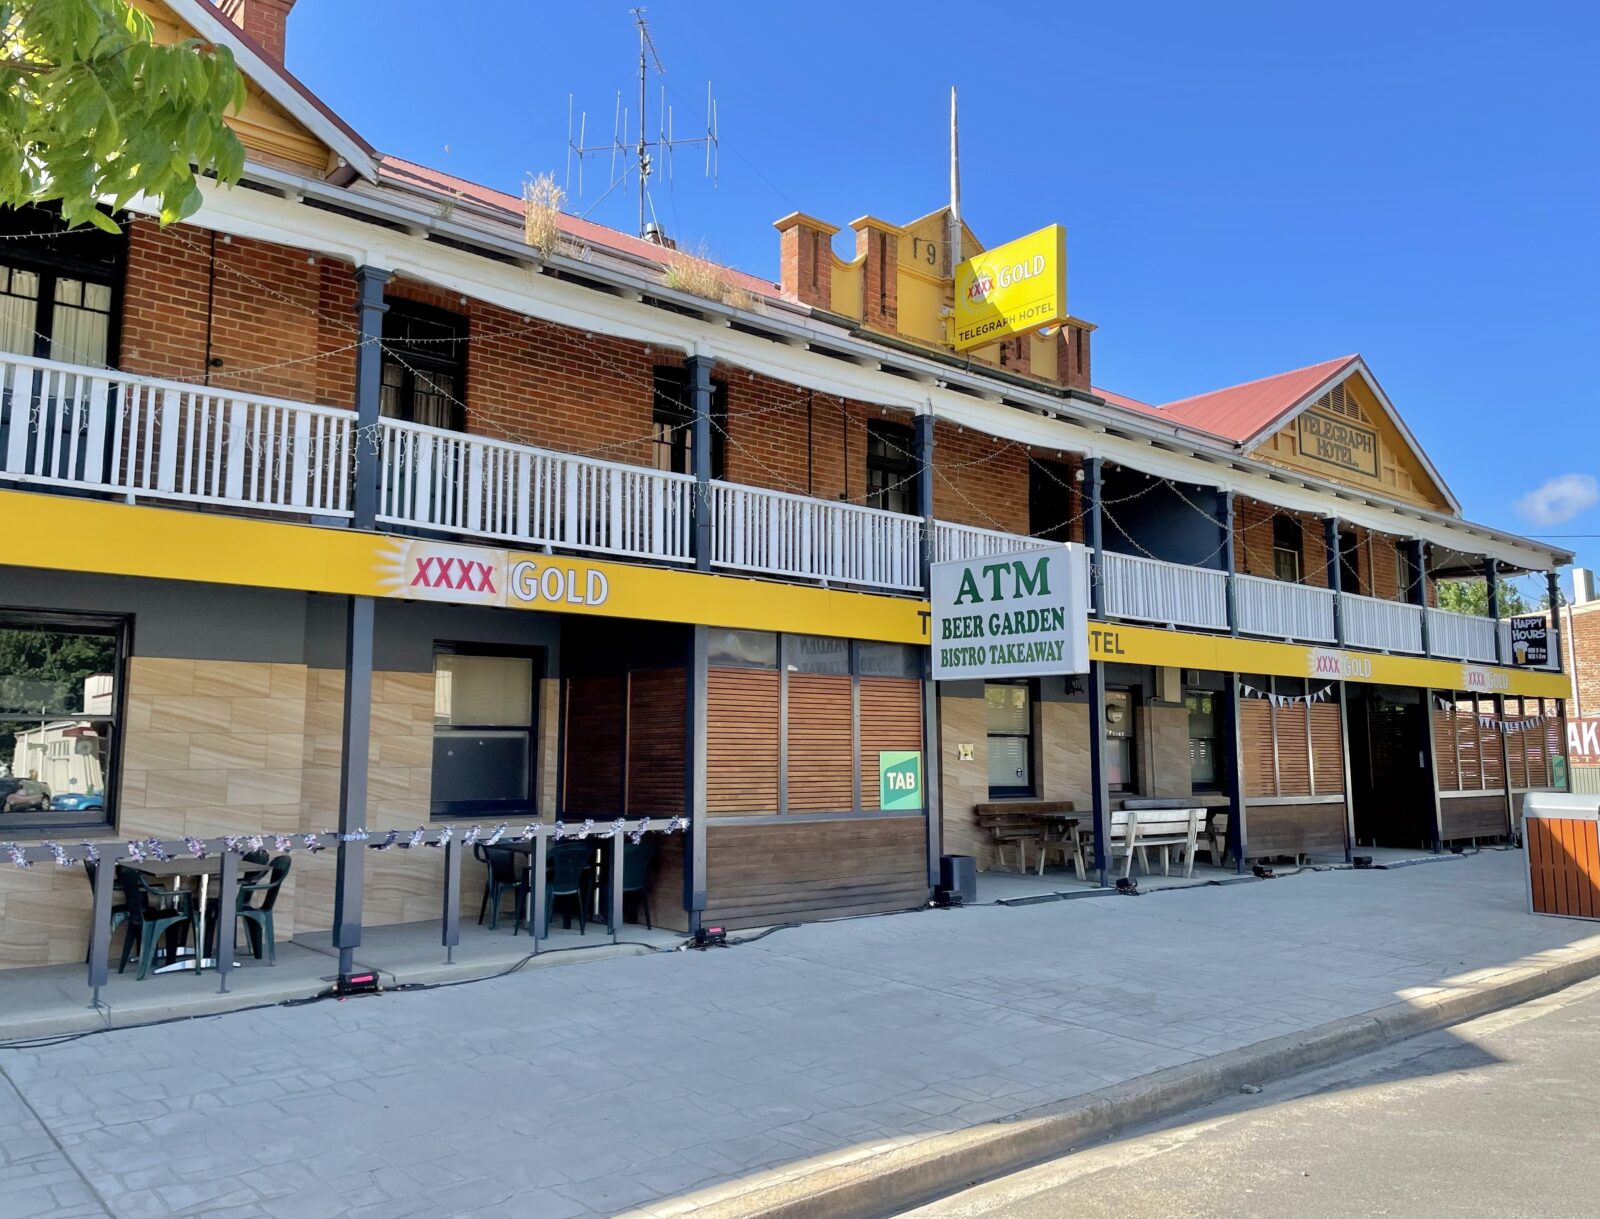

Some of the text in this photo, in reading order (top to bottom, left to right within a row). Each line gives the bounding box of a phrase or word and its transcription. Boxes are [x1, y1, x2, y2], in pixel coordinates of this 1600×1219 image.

[967, 255, 1046, 299] XXXX GOLD
[958, 301, 1055, 342] TELEGRAPH HOTEL
[1301, 412, 1372, 454] TELEGRAPH
[410, 556, 609, 606] XXXX GOLD
[953, 556, 1052, 606] ATM
[941, 614, 985, 640] BEER
[988, 606, 1065, 637] GARDEN
[1512, 628, 1546, 641] HOURS
[1513, 617, 1543, 629] HAPPY
[940, 640, 1065, 668] BISTRO TAKEAWAY
[1316, 655, 1372, 679] XXXX GOLD
[1468, 671, 1510, 690] XXXX GOLD
[886, 770, 916, 790] TAB
